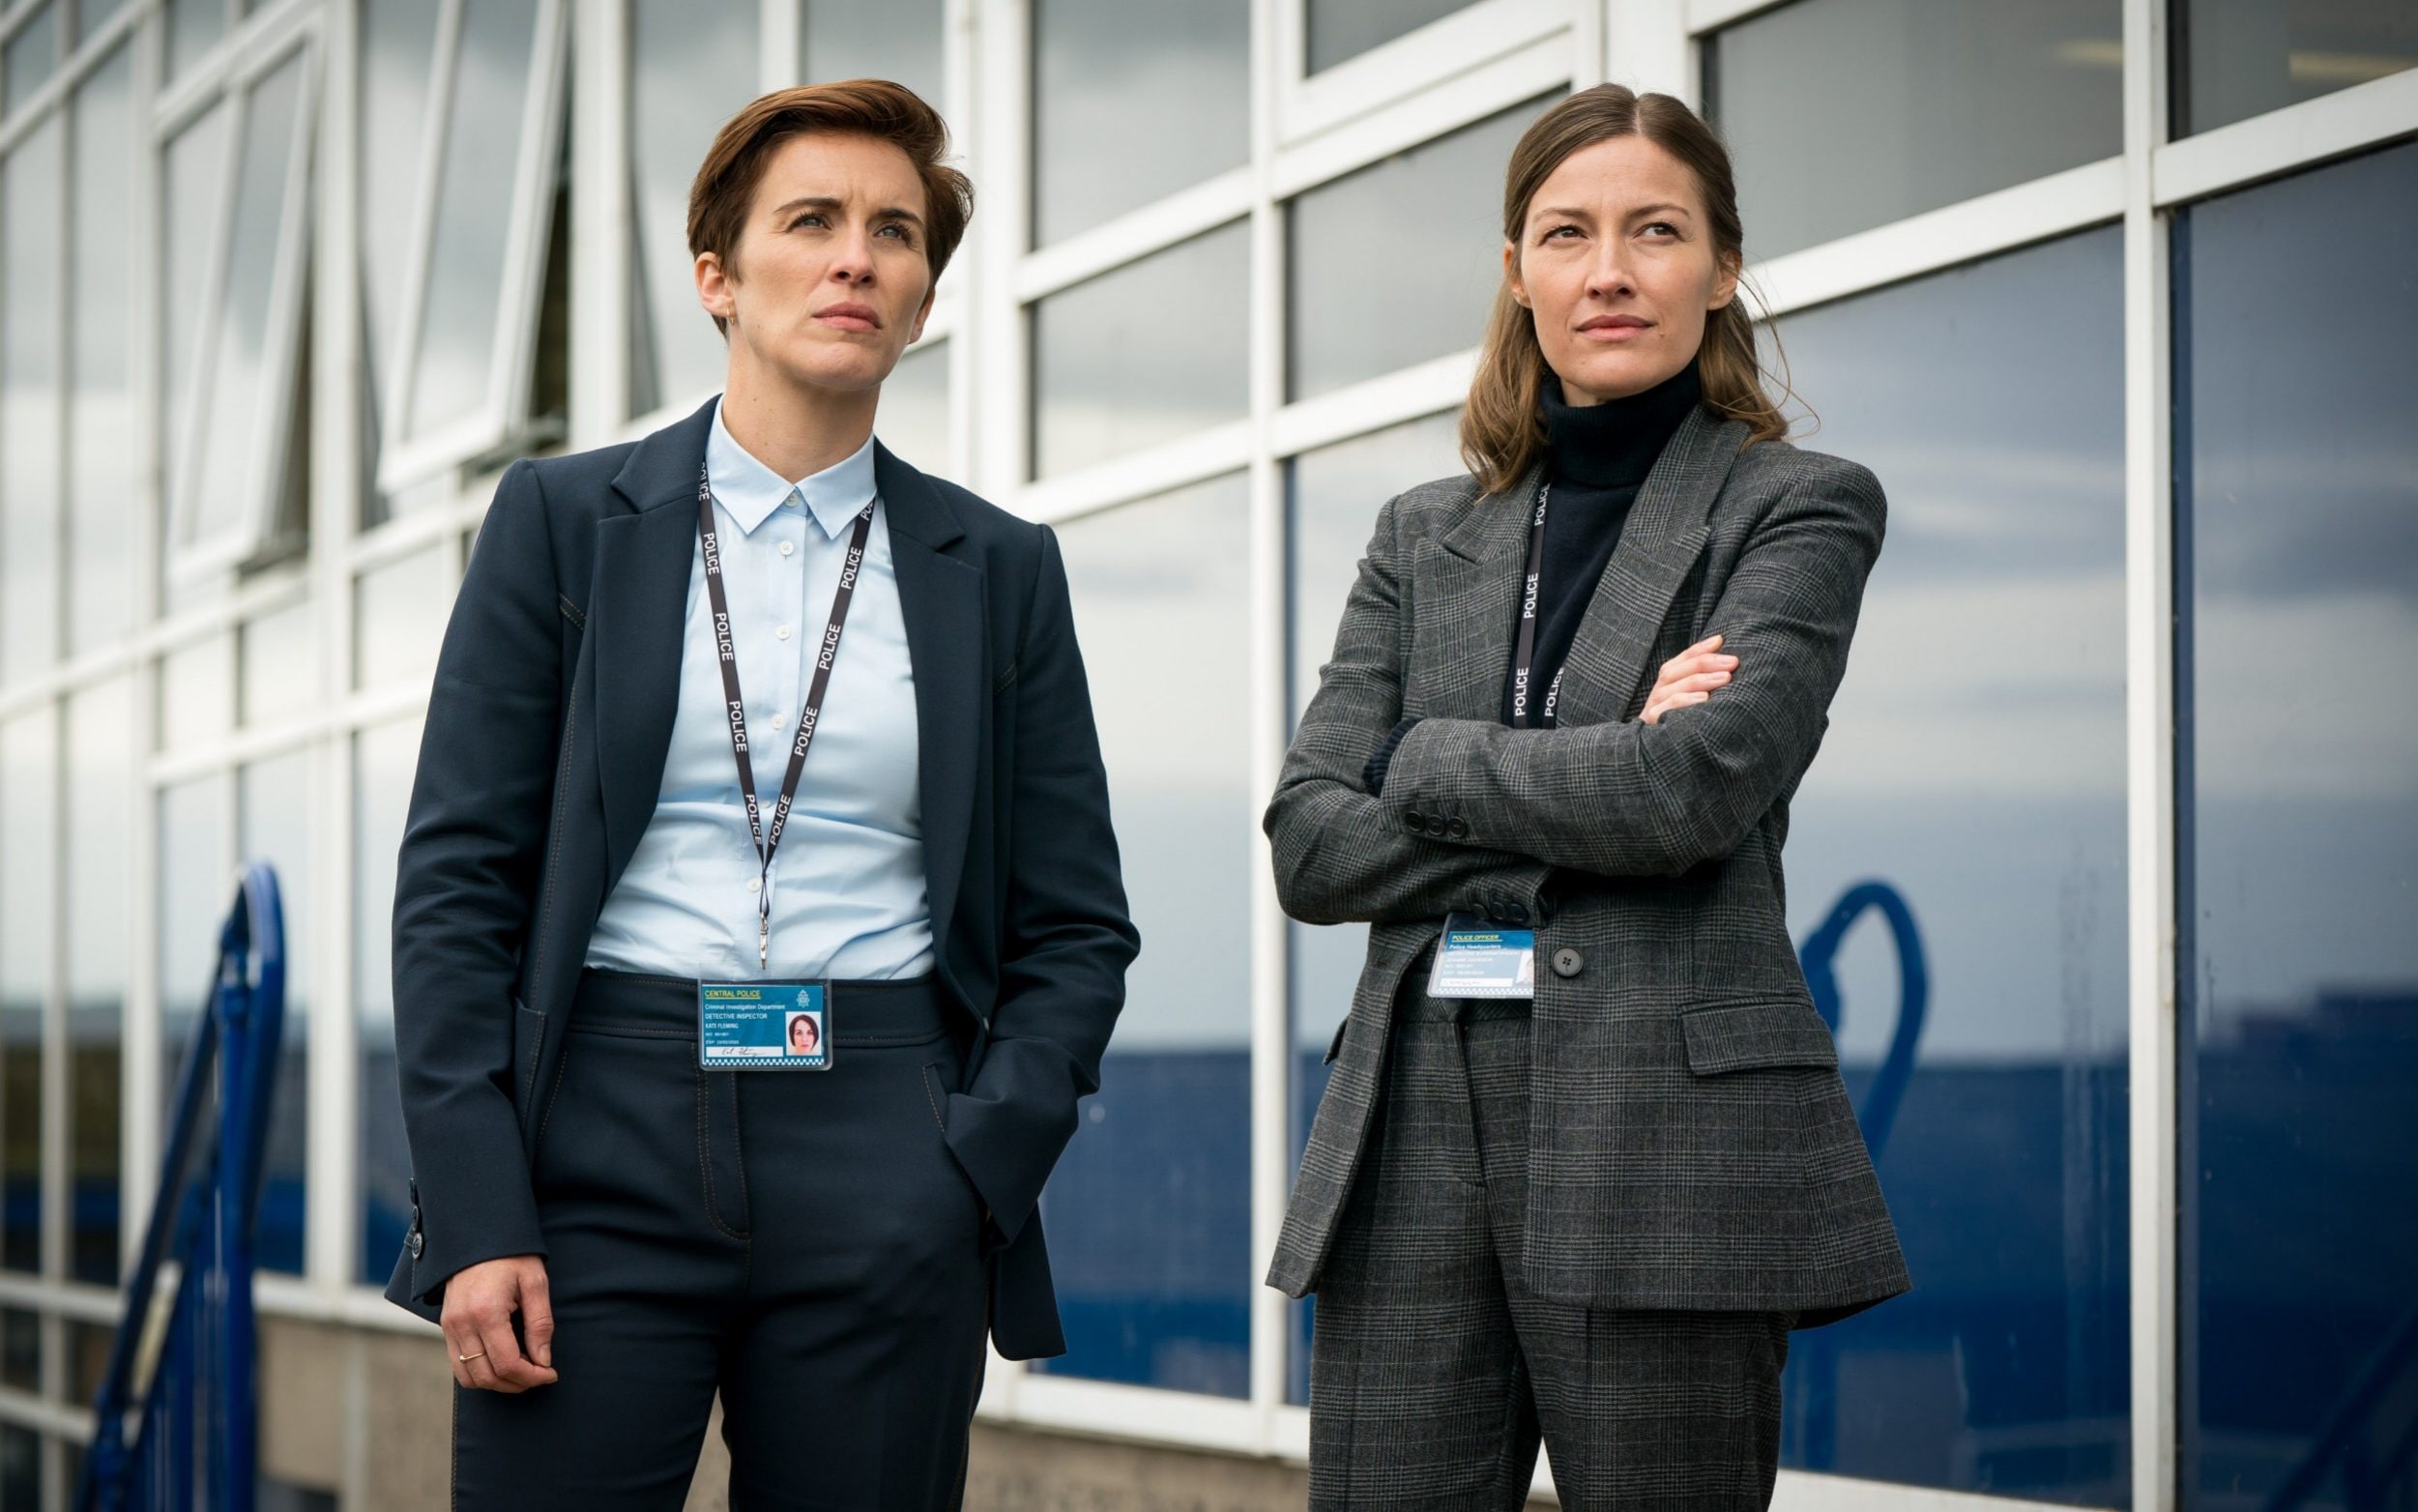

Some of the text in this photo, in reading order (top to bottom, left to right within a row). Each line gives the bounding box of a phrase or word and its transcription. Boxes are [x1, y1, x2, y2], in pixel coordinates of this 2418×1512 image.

[704, 533, 719, 575] POLICE
[841, 546, 862, 590] POLICE
[1524, 572, 1538, 619] POLICE
[715, 613, 734, 661] POLICE
[819, 624, 841, 670] POLICE
[1515, 667, 1529, 716] POLICE
[729, 701, 747, 752] POLICE
[794, 706, 818, 757] POLICE
[745, 794, 762, 845] POLICE
[770, 794, 792, 846] POLICE
